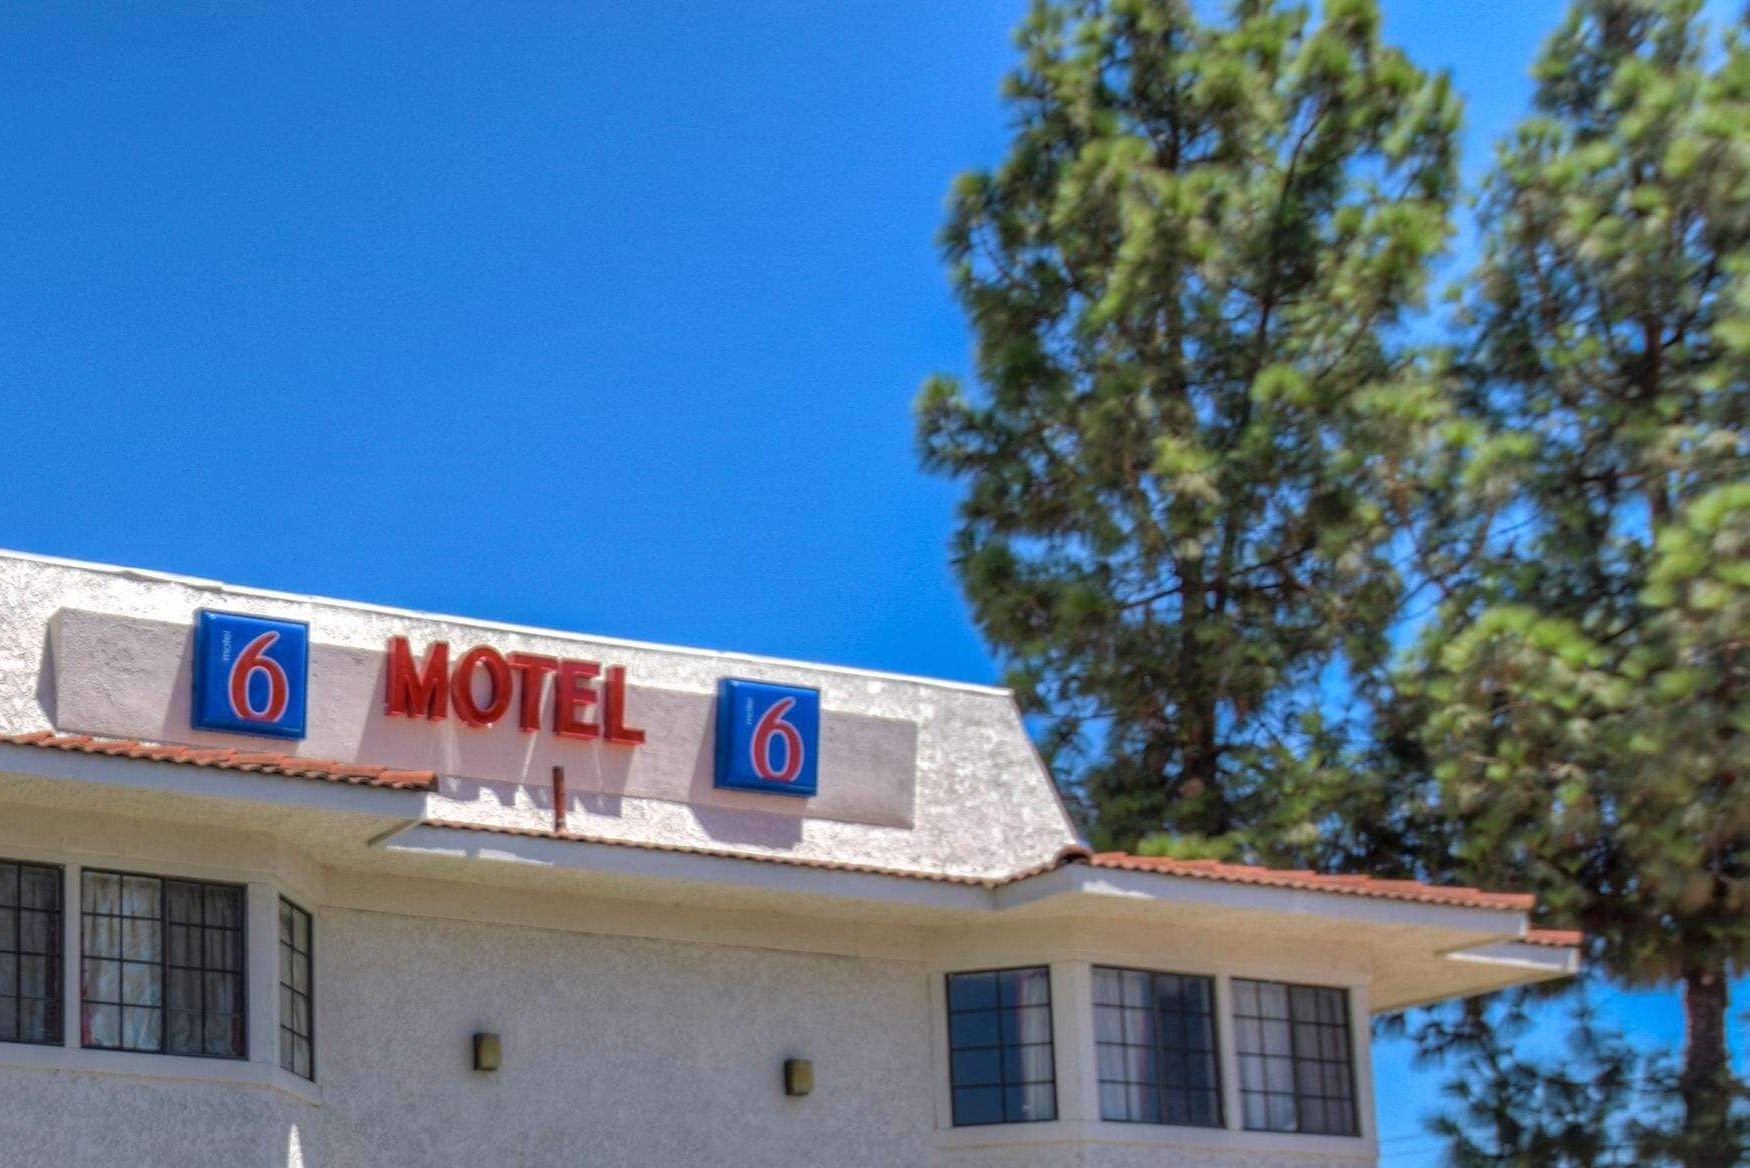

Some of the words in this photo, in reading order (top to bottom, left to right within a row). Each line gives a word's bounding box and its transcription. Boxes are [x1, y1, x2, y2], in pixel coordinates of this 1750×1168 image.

[228, 630, 289, 723] 6
[384, 634, 646, 745] MOTEL
[750, 695, 805, 783] 6
